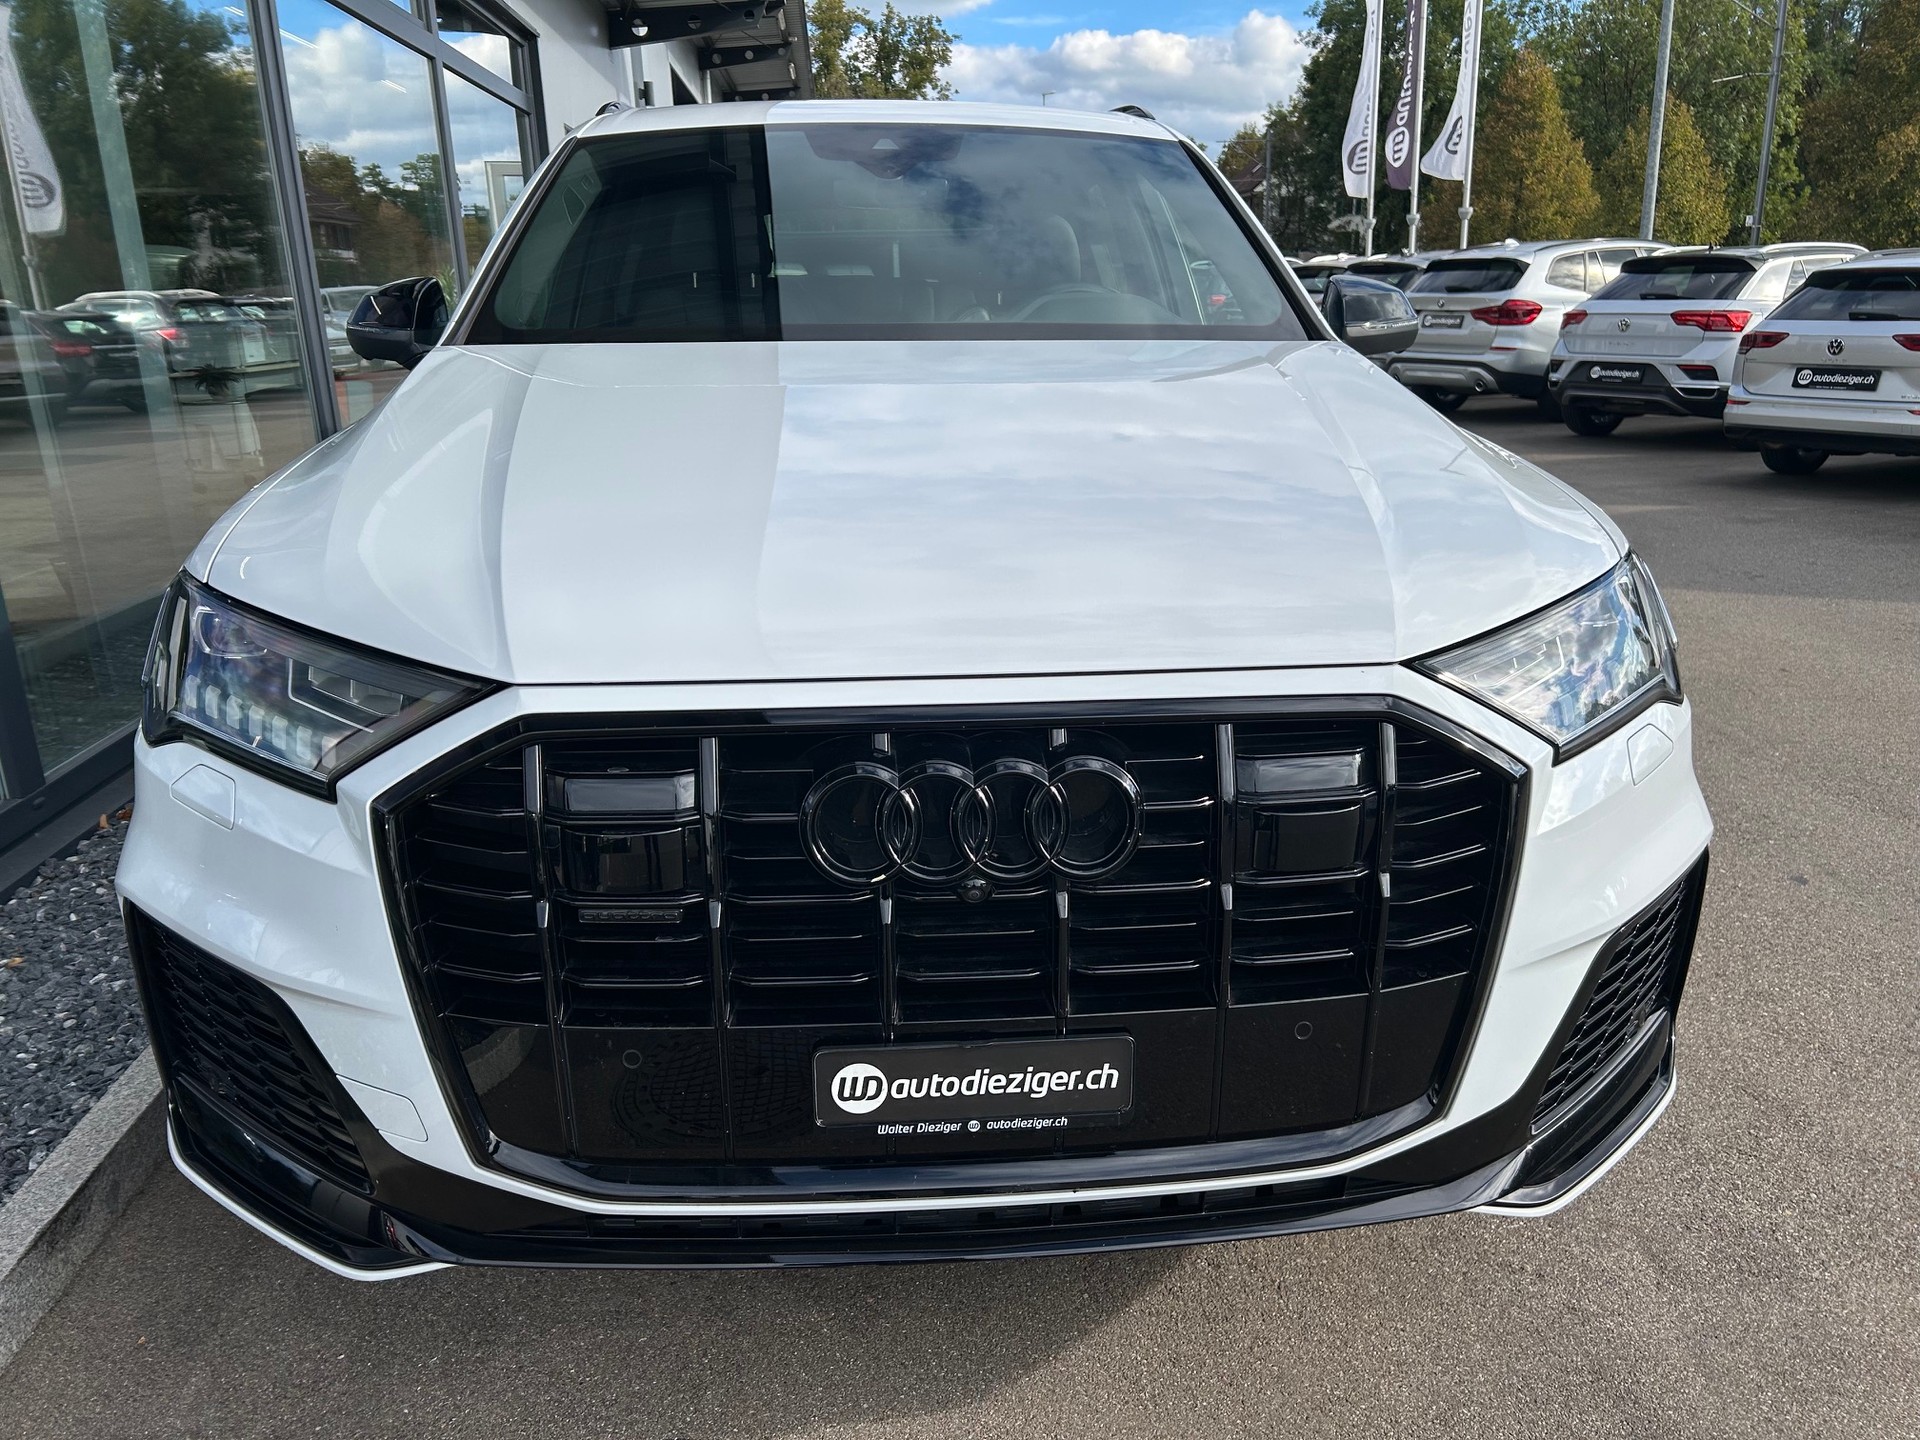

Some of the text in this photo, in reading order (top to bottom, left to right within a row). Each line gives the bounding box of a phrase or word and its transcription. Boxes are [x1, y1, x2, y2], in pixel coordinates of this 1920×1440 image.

[1812, 373, 1875, 385] autodieziger.ch
[890, 1063, 1119, 1099] autodieziger.ch
[877, 1123, 915, 1135] Walter
[916, 1121, 962, 1134] Dieziger
[986, 1116, 1068, 1130] autodieziger.ch
